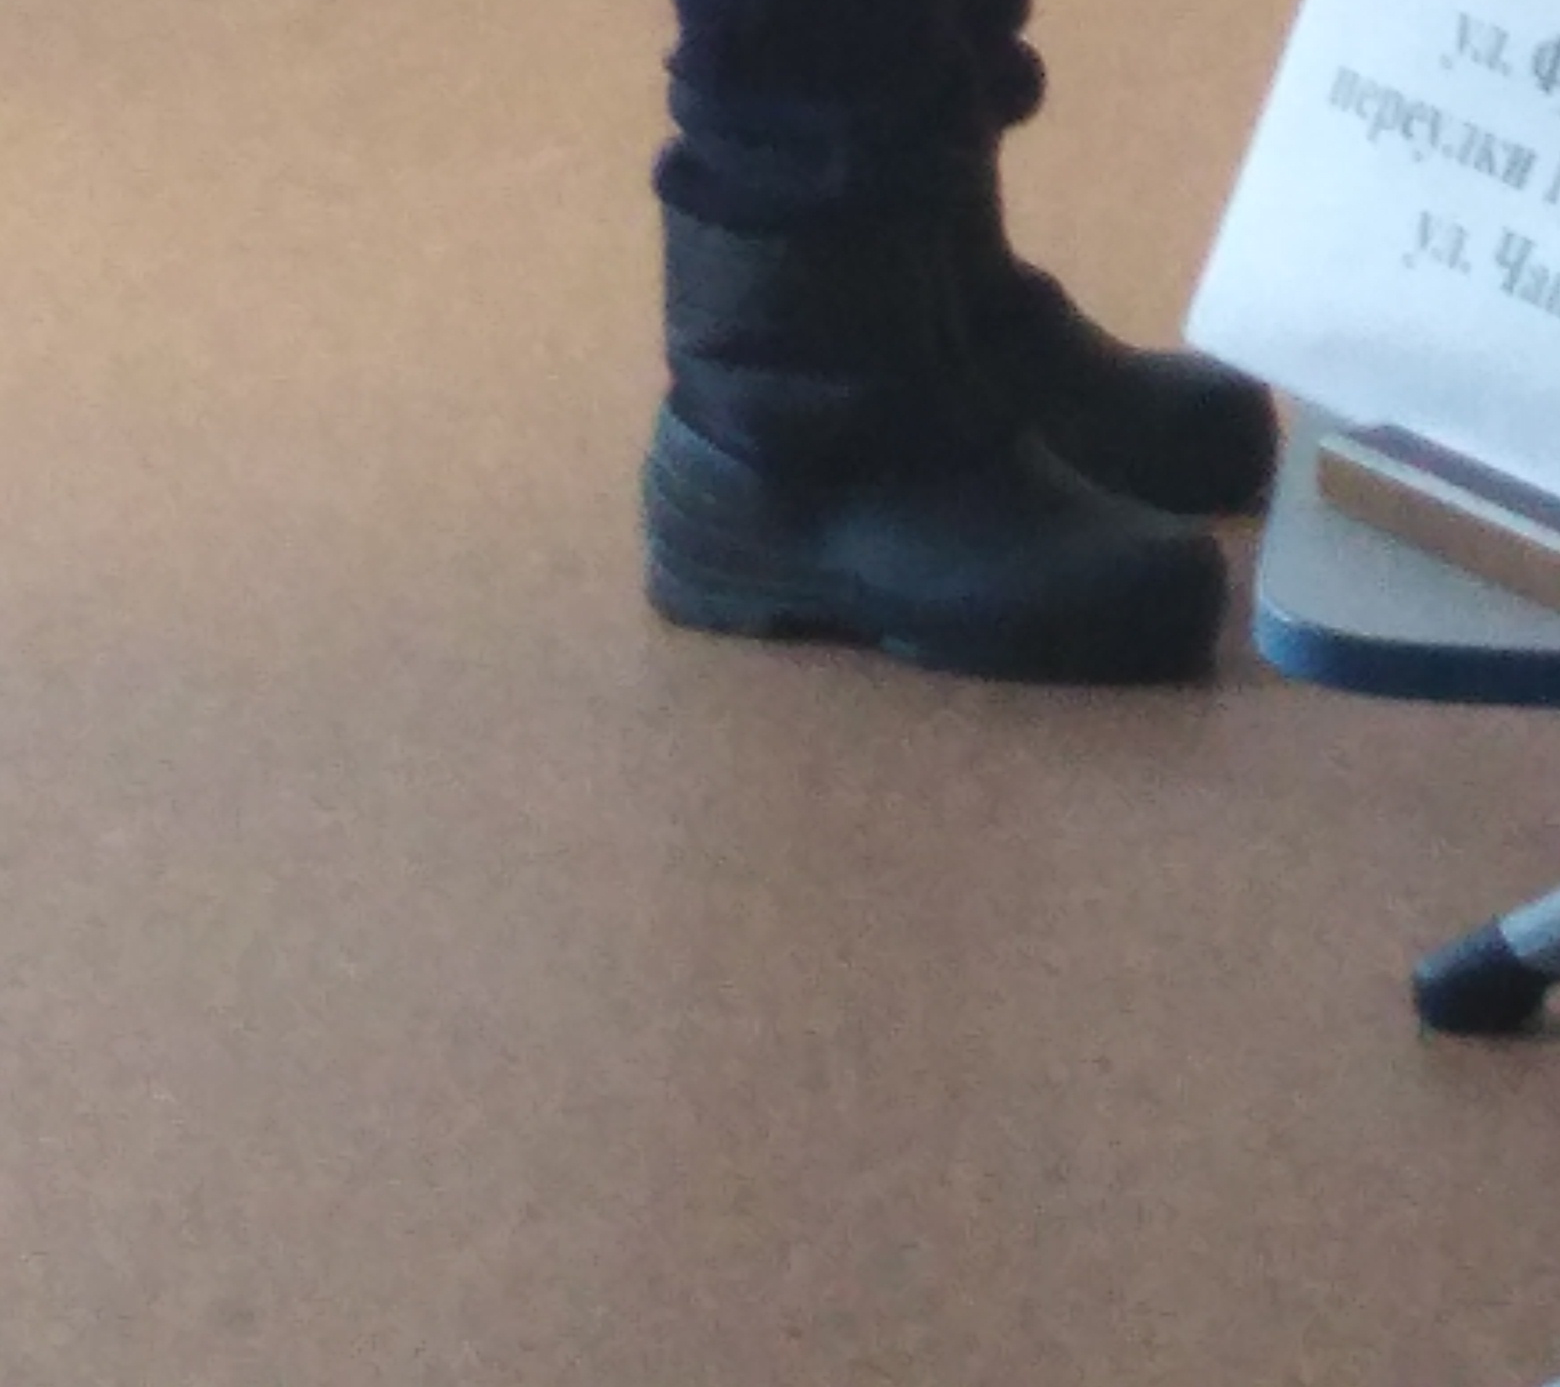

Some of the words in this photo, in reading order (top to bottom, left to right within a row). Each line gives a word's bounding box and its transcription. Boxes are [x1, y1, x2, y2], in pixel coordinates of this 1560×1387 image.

[1440, 11, 1513, 77] ул.
[1327, 64, 1539, 192] переулки
[1400, 209, 1473, 275] ул.
